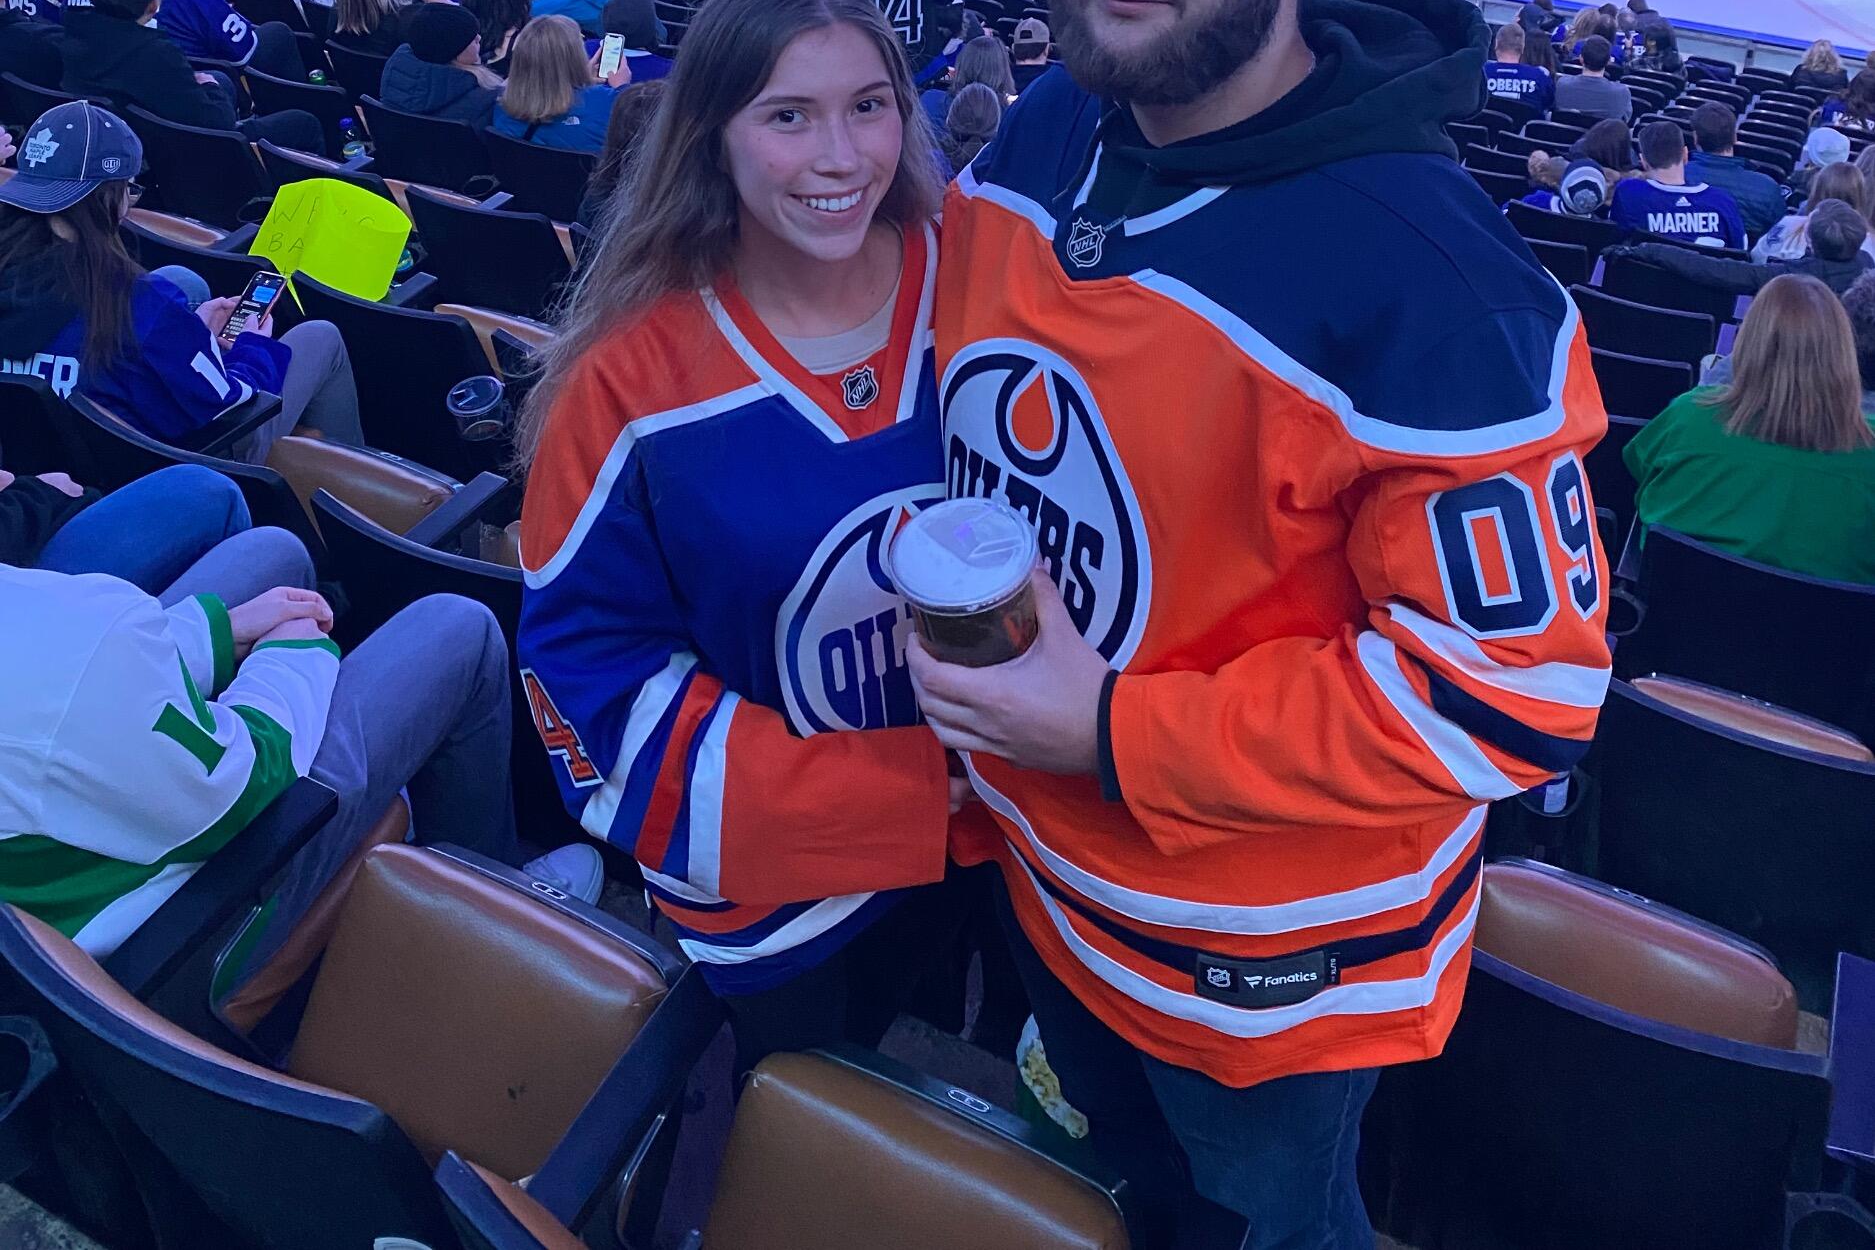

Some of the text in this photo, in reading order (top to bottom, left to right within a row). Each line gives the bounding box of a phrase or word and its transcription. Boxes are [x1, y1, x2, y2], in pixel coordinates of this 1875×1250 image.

[222, 13, 248, 43] 3
[1487, 78, 1537, 93] OBERTS
[1648, 212, 1720, 234] MARNER
[1073, 237, 1095, 253] NHL
[852, 374, 872, 405] NHL
[1425, 450, 1600, 643] 09
[819, 602, 930, 731] OIL
[520, 668, 605, 789] 4
[1265, 970, 1318, 988] Fanatics
